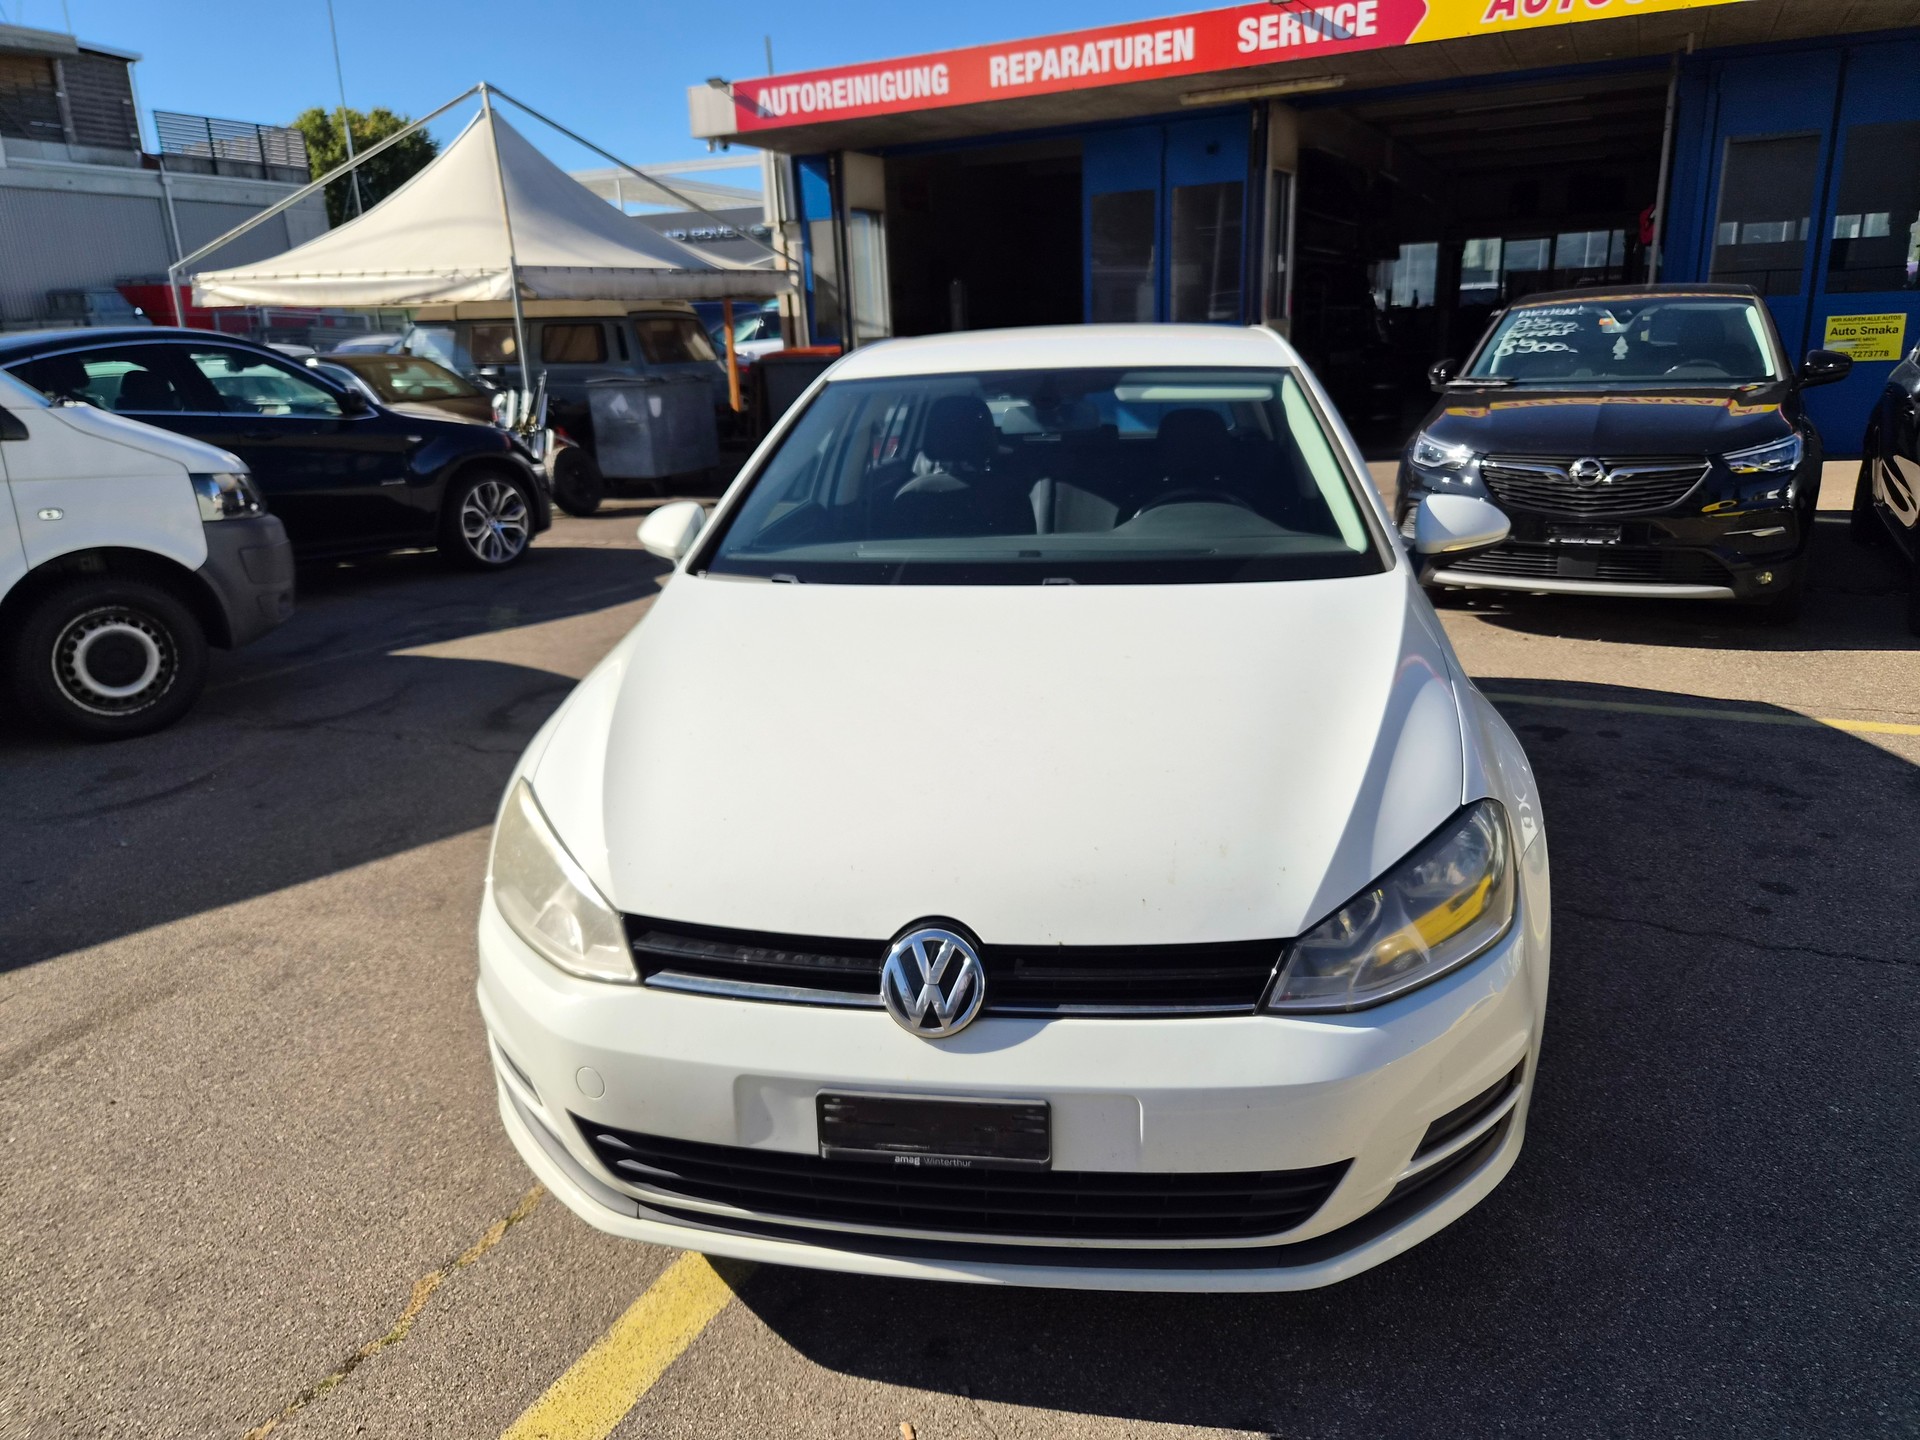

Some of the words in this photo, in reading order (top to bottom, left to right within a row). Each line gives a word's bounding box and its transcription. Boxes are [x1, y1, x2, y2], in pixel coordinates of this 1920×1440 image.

[757, 63, 949, 118] AUTOREINIGUNG
[989, 27, 1195, 88] REPARATUREN
[1237, 0, 1378, 53] SERVICE
[1830, 327, 1857, 336] Auto
[1860, 325, 1899, 335] Smaka
[894, 1155, 921, 1166] amag
[924, 1156, 972, 1167] Winterthur
